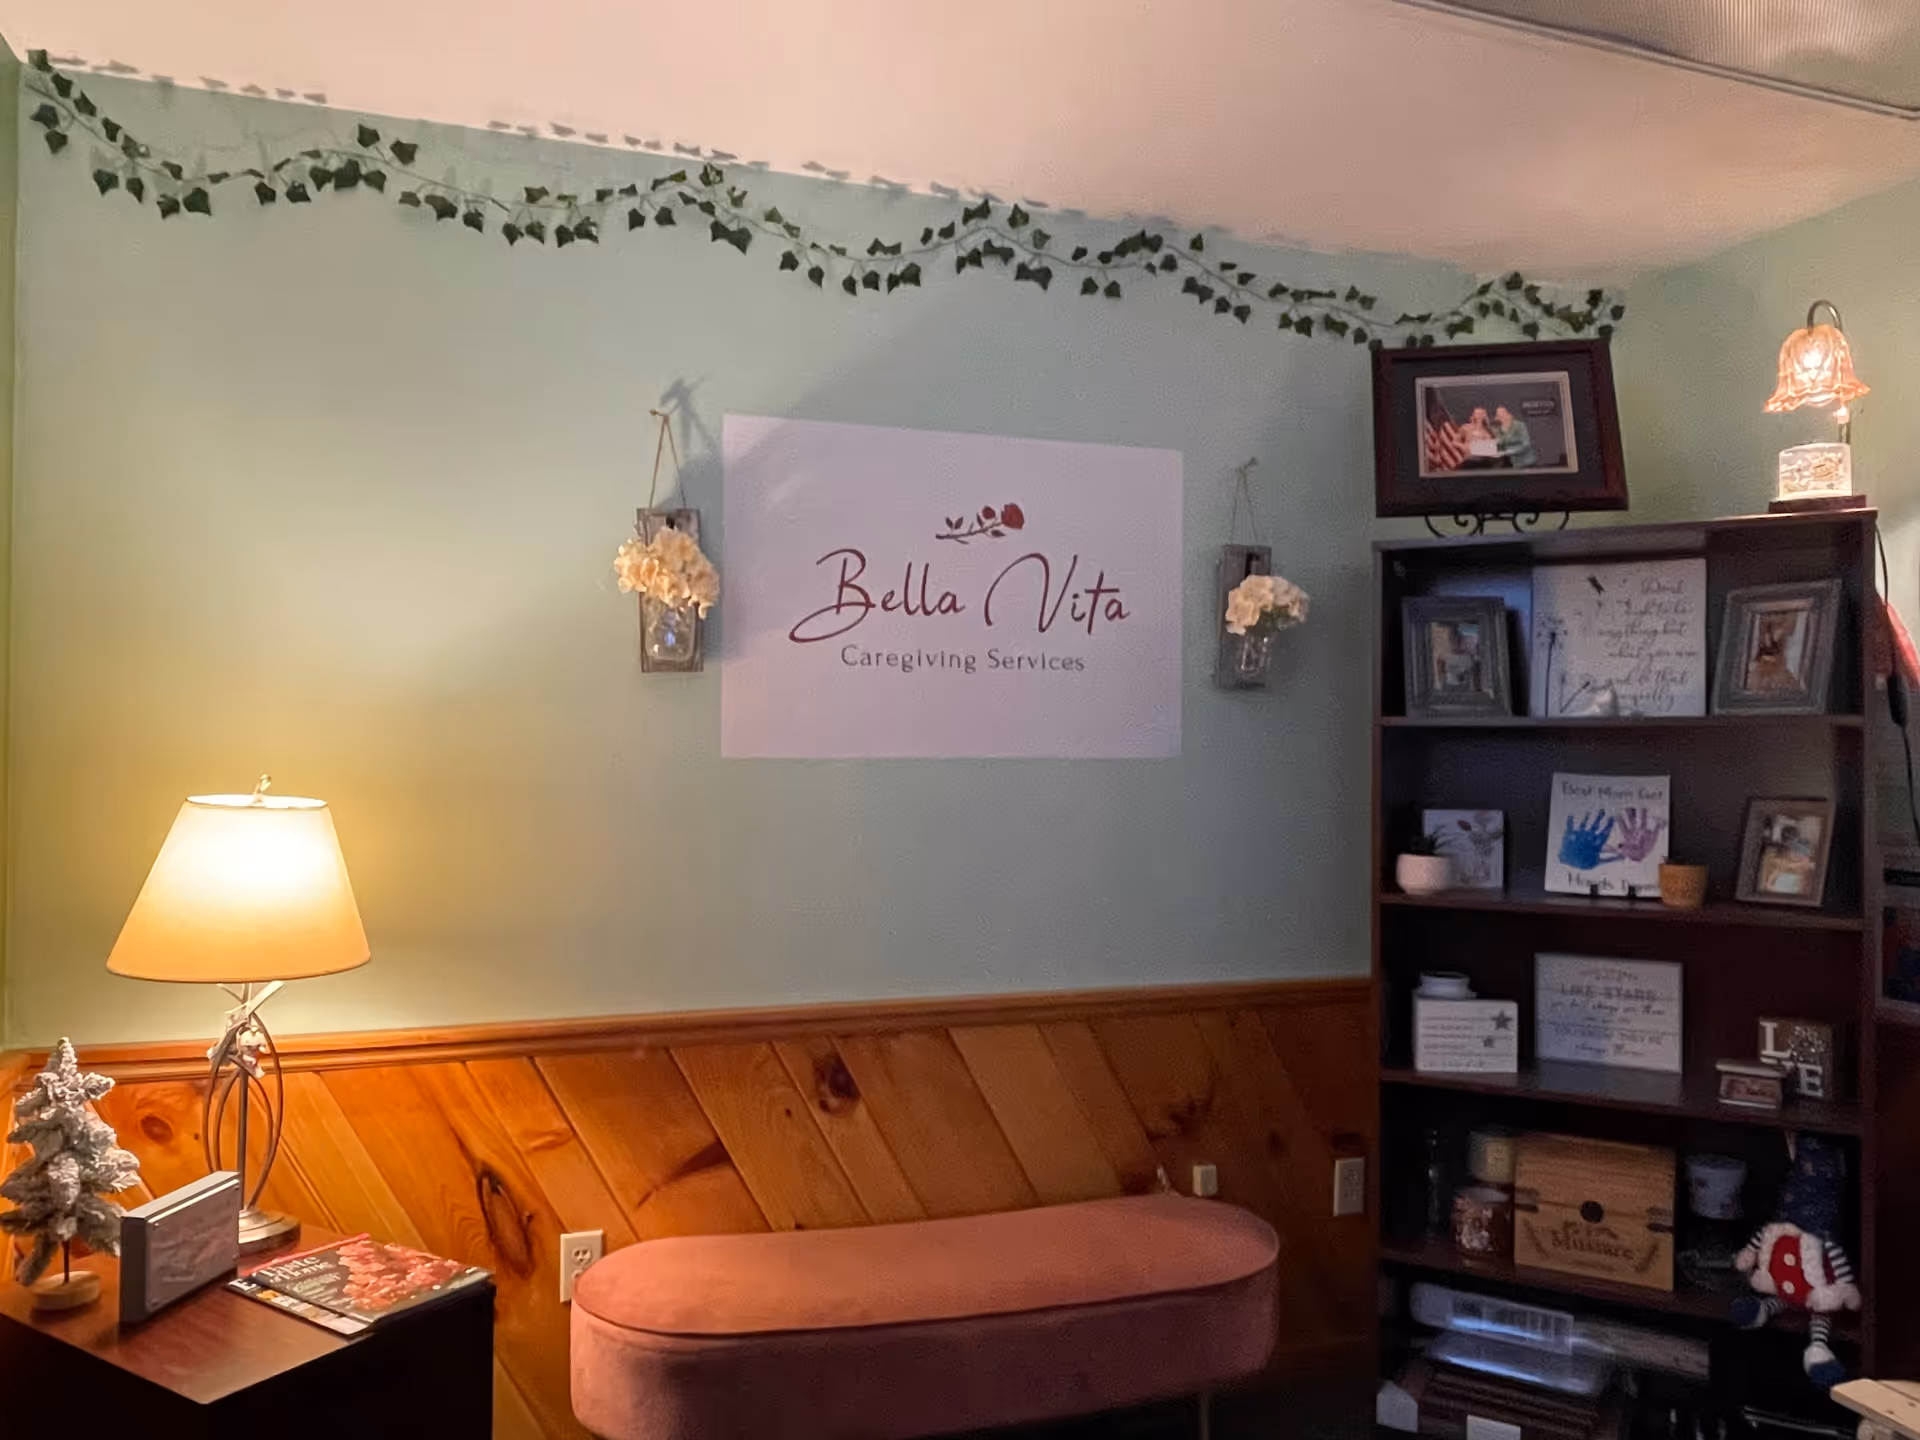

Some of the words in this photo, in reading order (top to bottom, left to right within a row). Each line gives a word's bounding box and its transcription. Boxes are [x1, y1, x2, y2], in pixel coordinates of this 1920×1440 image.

[788, 548, 966, 643] Bella
[983, 552, 1130, 635] Vita
[840, 644, 977, 674] Caregiving
[987, 648, 1086, 673] Services
[1561, 781, 1593, 796] Best
[1598, 785, 1634, 799] Mom
